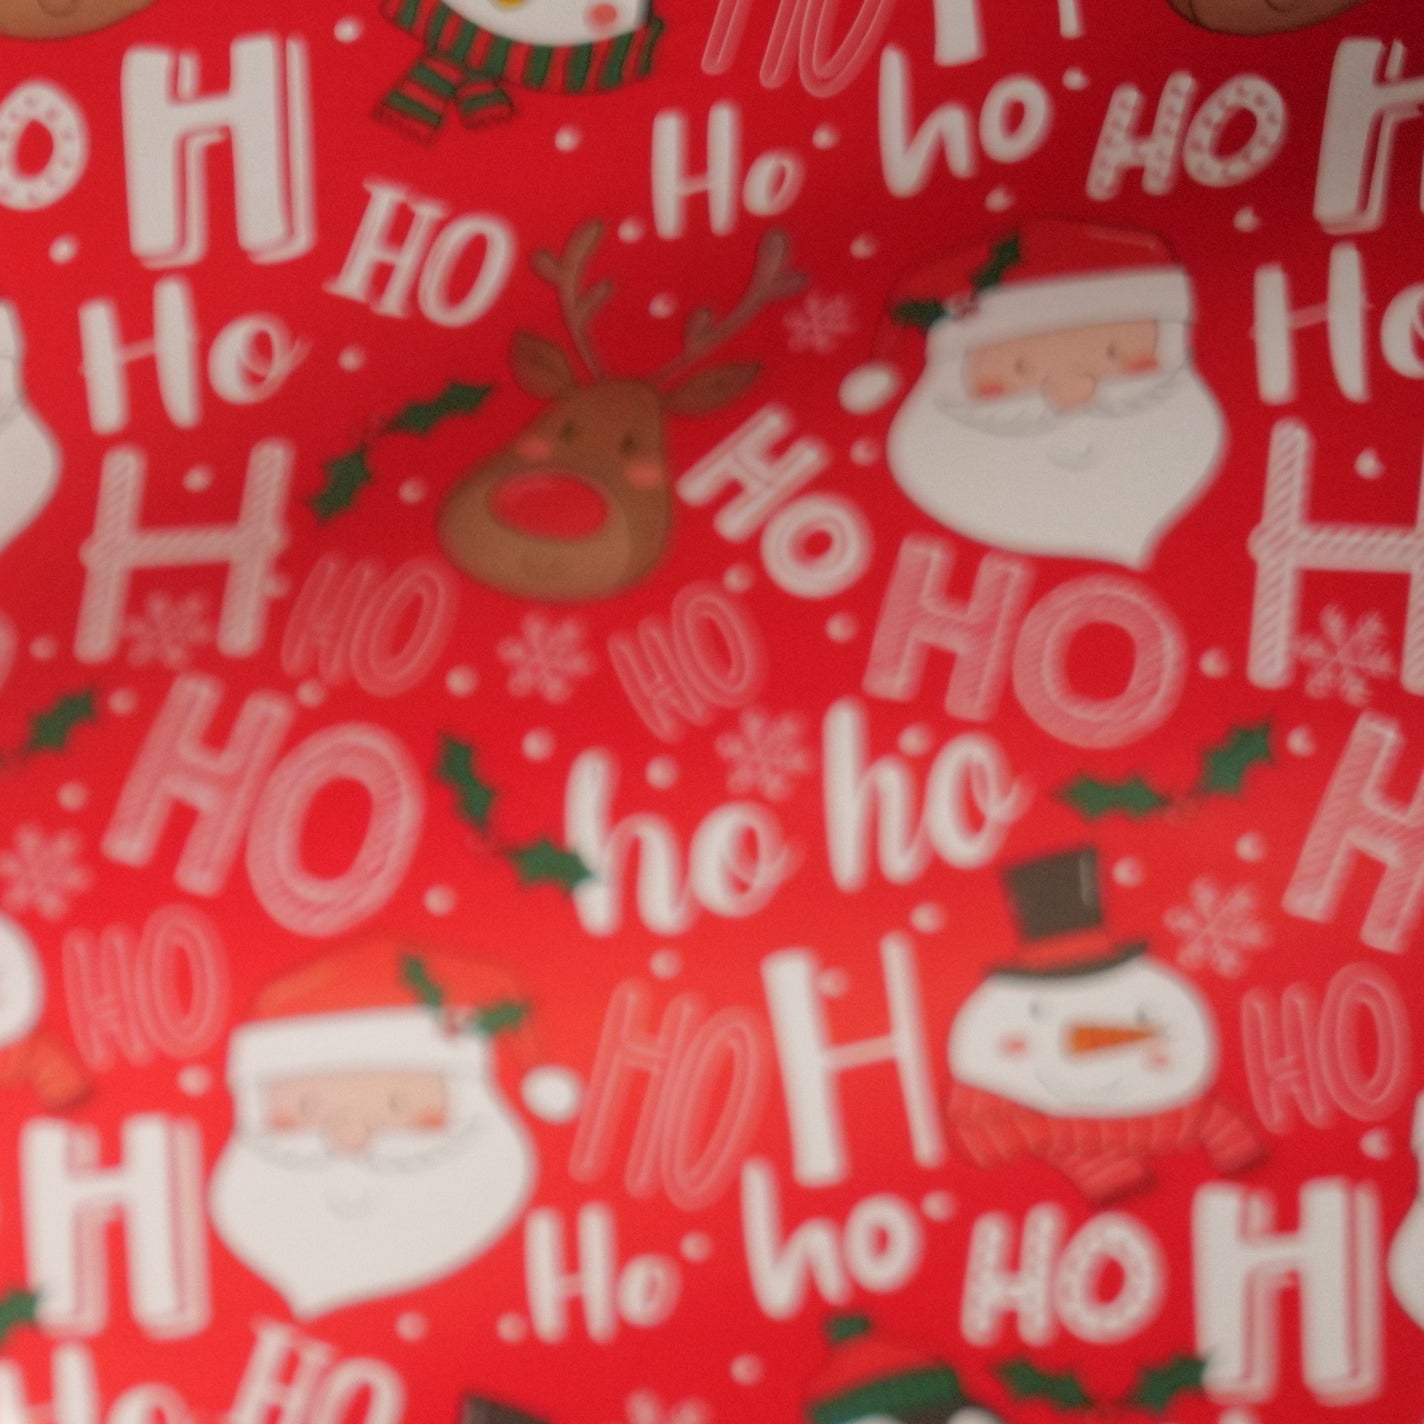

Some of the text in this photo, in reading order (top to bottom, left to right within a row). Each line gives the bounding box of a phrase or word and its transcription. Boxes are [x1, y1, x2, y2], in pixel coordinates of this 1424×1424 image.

[120, 33, 316, 269] H
[652, 101, 804, 239] Ho
[878, 43, 1051, 198] ho
[1086, 70, 1285, 200] HO
[322, 178, 516, 327] HO
[78, 276, 312, 434] Ho
[72, 437, 296, 664] H
[676, 405, 873, 598] HO
[280, 553, 455, 698] HO
[606, 580, 767, 744] HO
[862, 533, 1187, 750] HO
[101, 671, 425, 938] HO
[565, 746, 807, 938] ho
[820, 696, 1037, 893] ho
[61, 903, 232, 1072] HO
[760, 930, 948, 1188] H
[1241, 961, 1410, 1135] HO
[568, 977, 769, 1211] HO
[18, 1110, 213, 1341] H
[523, 1202, 684, 1346] Ho
[740, 1155, 924, 1322] ho
[960, 1202, 1169, 1348] HO
[1191, 1176, 1384, 1407] H
